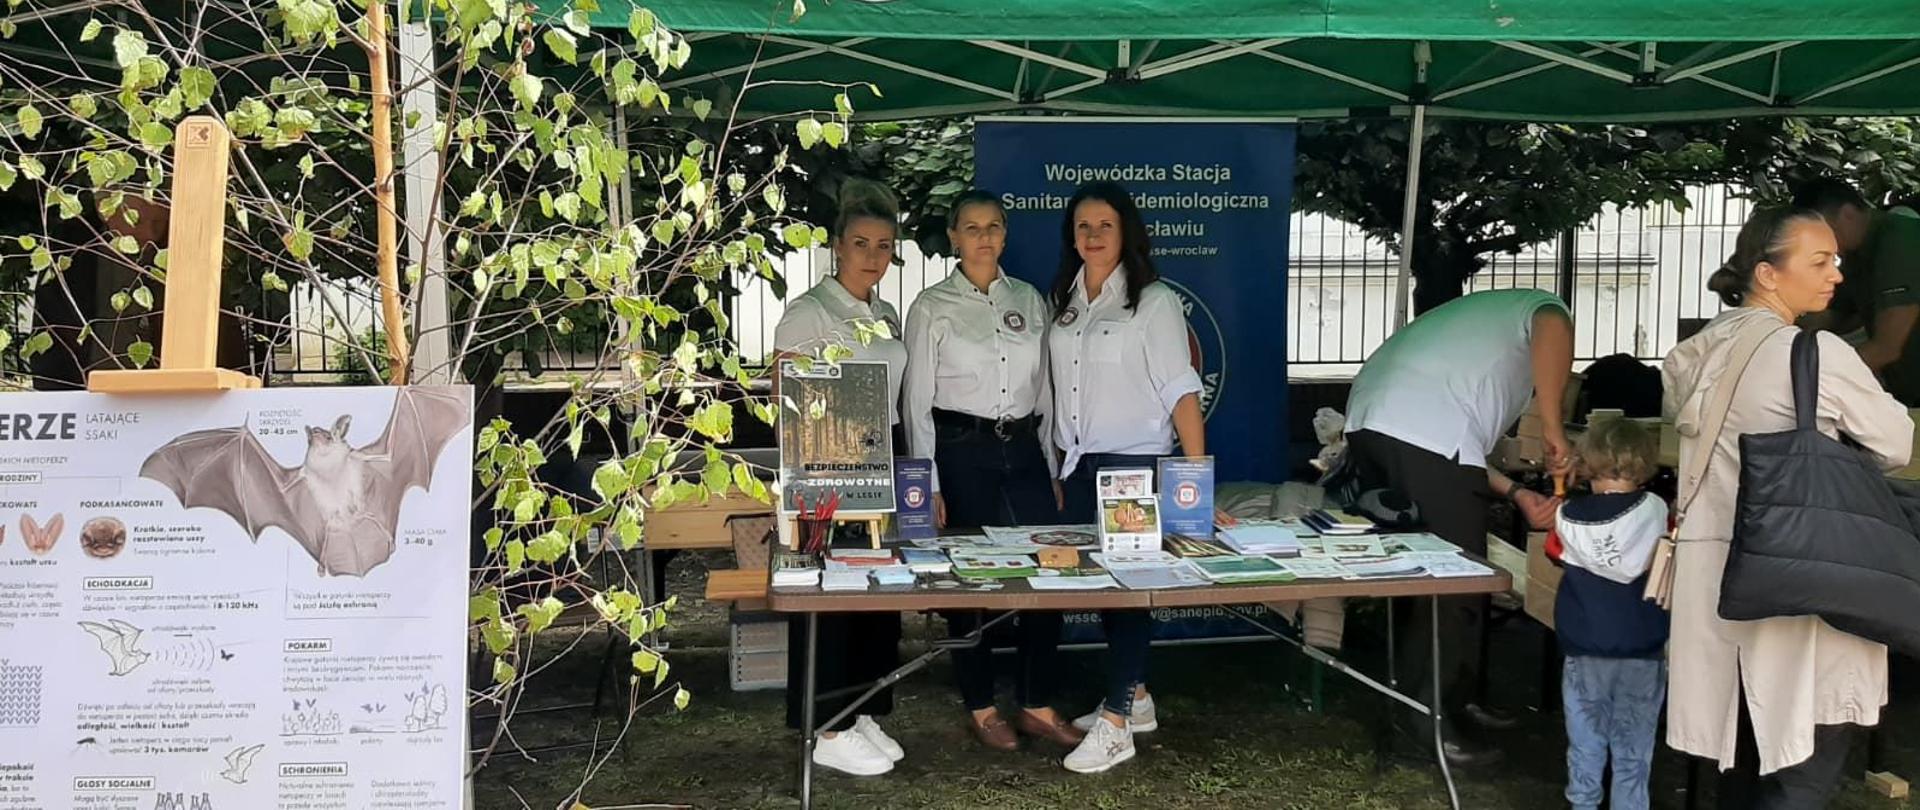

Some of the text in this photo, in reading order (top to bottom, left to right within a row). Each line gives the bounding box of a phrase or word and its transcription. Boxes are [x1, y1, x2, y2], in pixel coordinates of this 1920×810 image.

[1045, 164, 1231, 185] Wojewódzka Stacja
[1001, 192, 1072, 210] Sanitar
[86, 412, 140, 425] LATAJĄCE
[85, 429, 118, 440] SSAKI
[804, 462, 888, 471] BEZPIECZEŃSTWO
[1603, 534, 1622, 567] NYC
[87, 580, 149, 588] ECHOLOKACJA
[288, 642, 328, 650] POKARM
[283, 766, 343, 775] SCHRONIENIA
[77, 779, 151, 788] GŁOSY SOCJALNE
